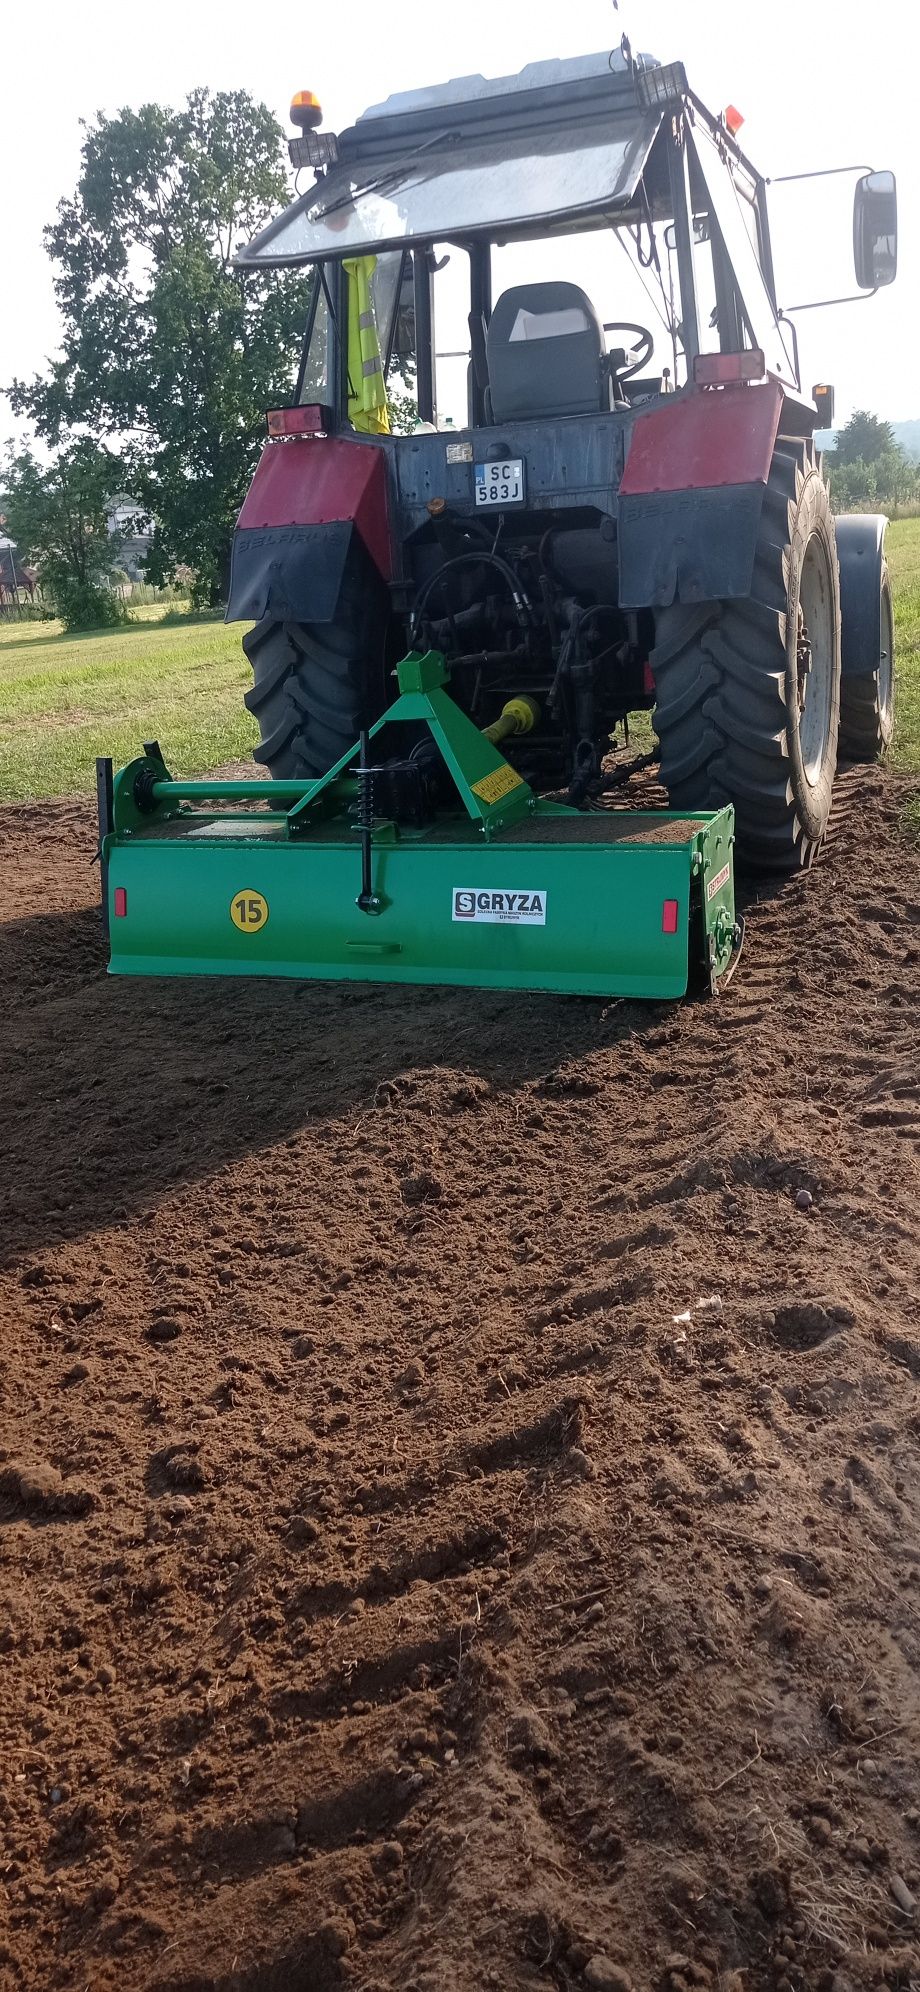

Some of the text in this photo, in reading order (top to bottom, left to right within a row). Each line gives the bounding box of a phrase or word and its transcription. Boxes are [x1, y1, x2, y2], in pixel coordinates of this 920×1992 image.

[491, 465, 511, 481] SC
[479, 483, 519, 502] 583J
[235, 899, 262, 923] 15
[477, 892, 543, 912] GRYZA
